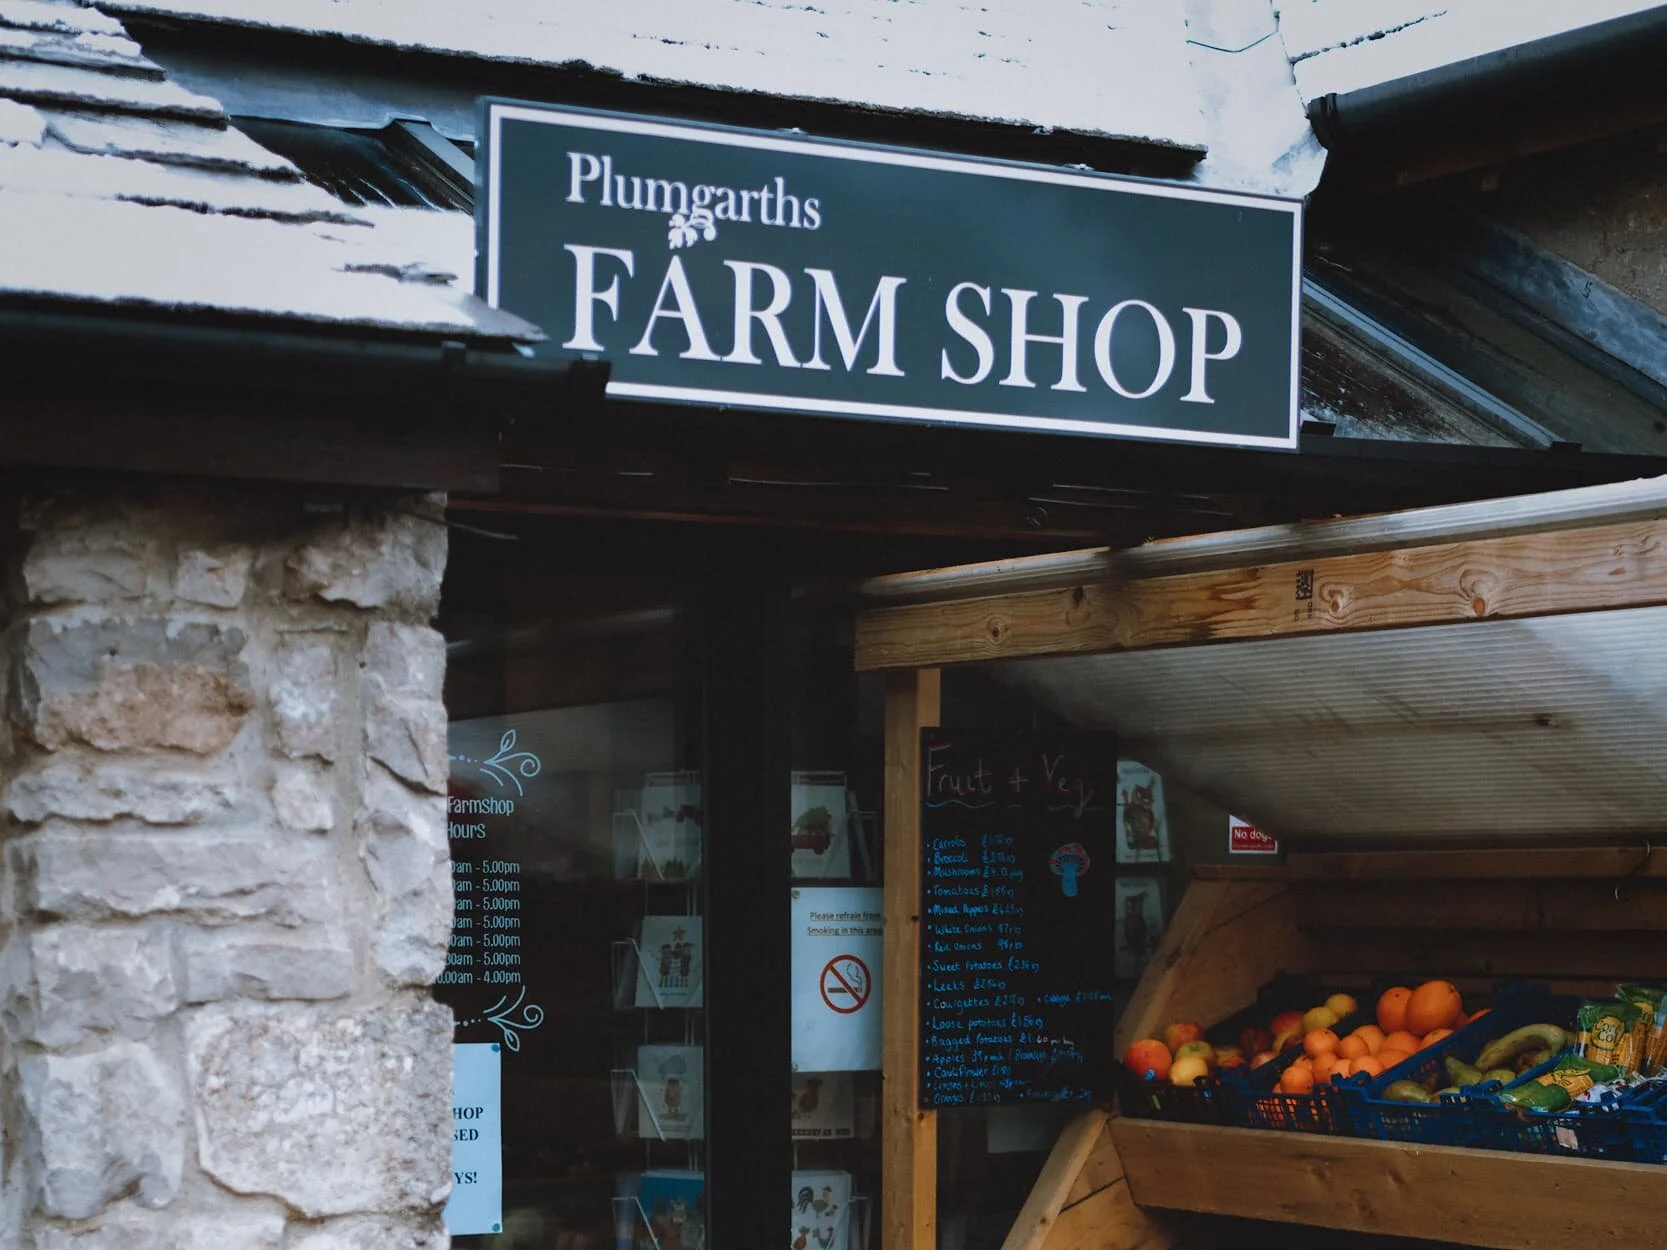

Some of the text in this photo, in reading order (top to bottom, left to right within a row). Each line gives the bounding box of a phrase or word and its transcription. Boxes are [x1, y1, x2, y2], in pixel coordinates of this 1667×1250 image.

[566, 150, 822, 232] Plumgarths
[562, 243, 1242, 404] FARM SHOP
[927, 744, 993, 798] Fruit
[1041, 752, 1094, 819] Veg
[1234, 828, 1272, 842] No dog
[483, 860, 521, 874] 5.00pm
[483, 879, 521, 893] 5.00pm
[934, 884, 979, 896] Tomatoes
[483, 897, 521, 911] 5.00pm
[483, 915, 521, 930] 5.00pm
[810, 911, 835, 921] Please
[836, 911, 862, 921] refrain
[807, 926, 840, 936] Smoking
[841, 926, 849, 936] in
[850, 926, 864, 936] this
[483, 934, 521, 948] 5.00pm
[483, 952, 521, 966] 5.00pm
[933, 959, 961, 972] Sweet
[483, 971, 521, 985] 4.00pm
[933, 979, 965, 992] Leeks
[933, 998, 989, 1014] Courgettes
[932, 1016, 963, 1031] Loose
[932, 1036, 969, 1052] Bagged
